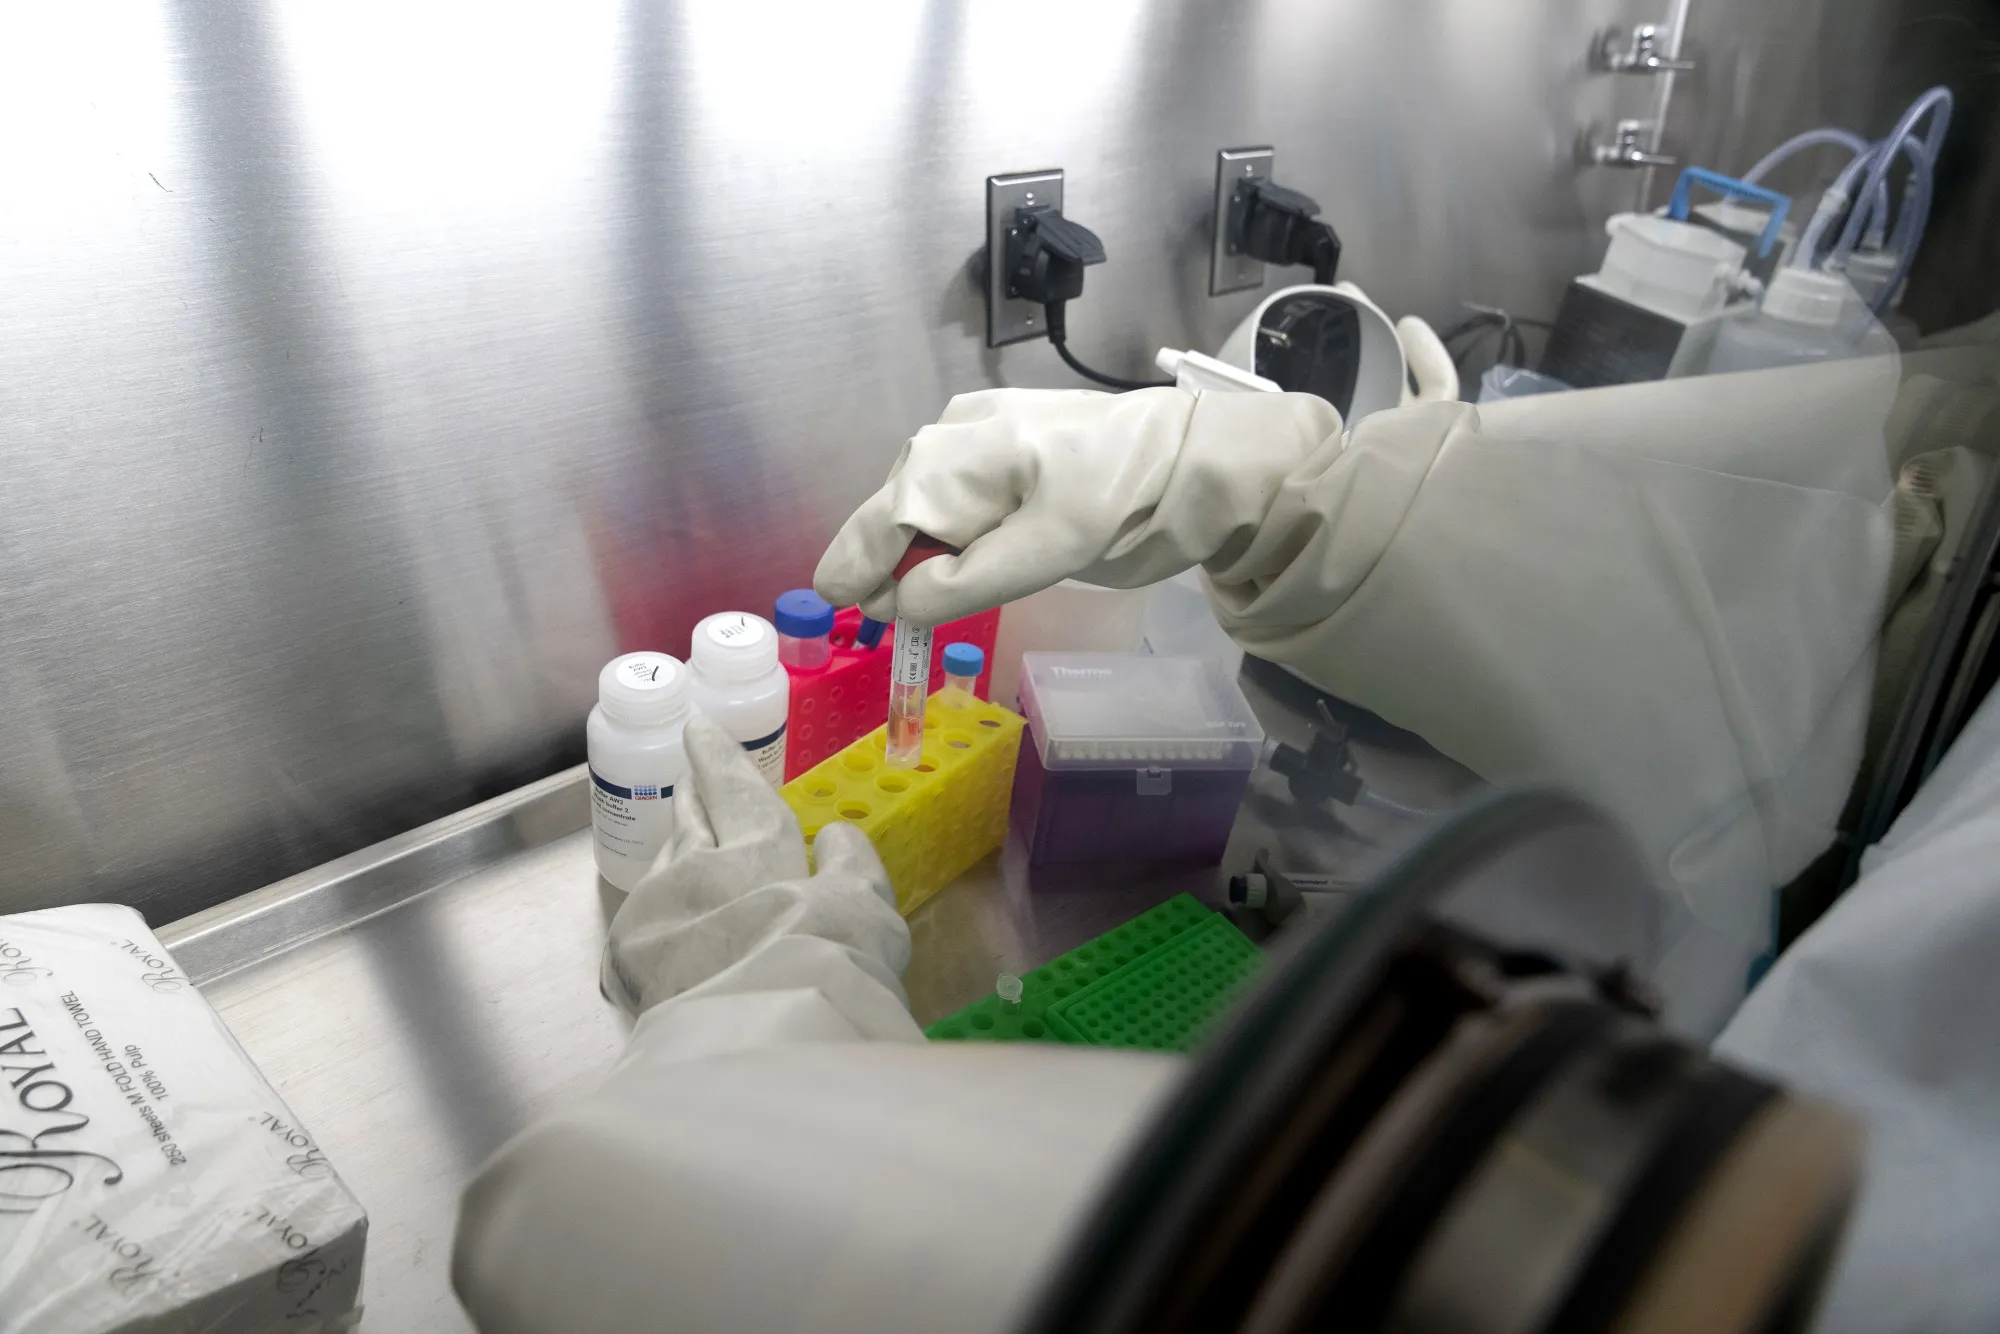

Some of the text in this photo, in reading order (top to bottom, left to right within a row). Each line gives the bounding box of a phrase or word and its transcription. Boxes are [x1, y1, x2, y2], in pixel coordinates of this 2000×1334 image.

[1050, 666, 1113, 679] Thermo
[121, 939, 194, 994] ROYAL
[60, 990, 187, 1166] 250 sheets M FOLD HAND TOWEL
[124, 1044, 170, 1101] 100% Pulp
[260, 1111, 333, 1176] ROYAL
[85, 1214, 181, 1291] ROYAL
